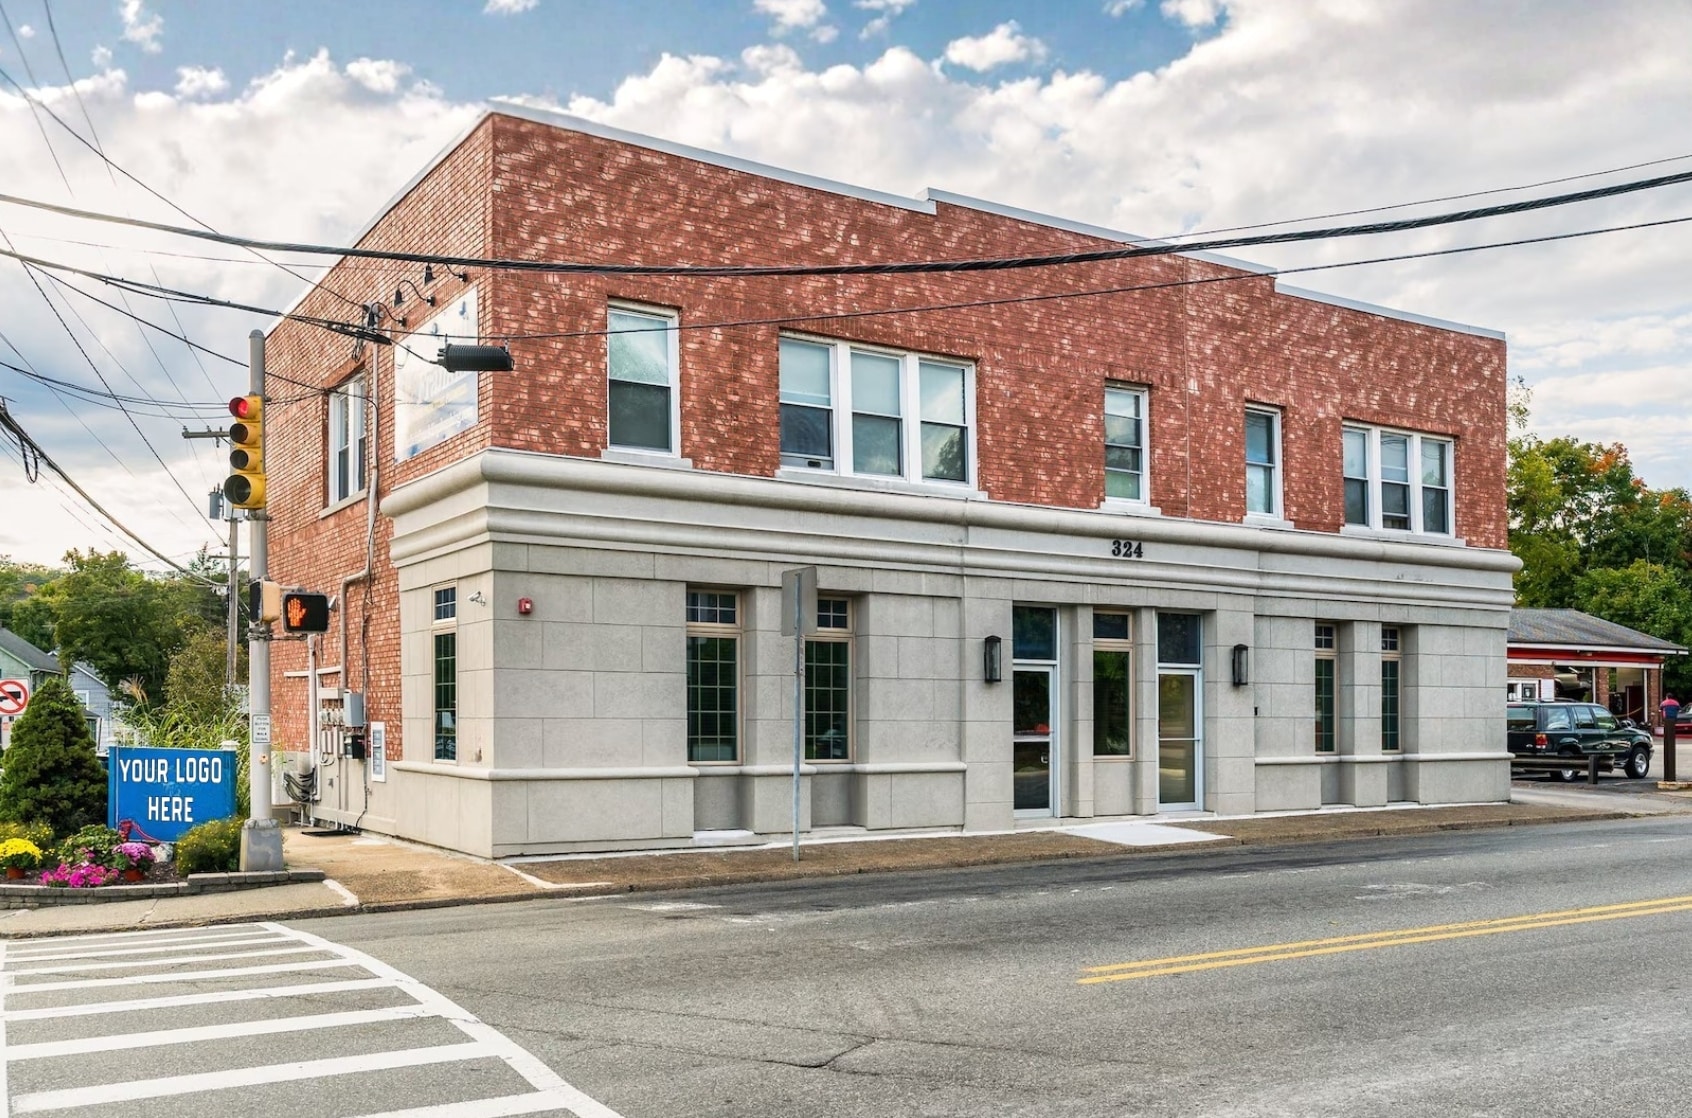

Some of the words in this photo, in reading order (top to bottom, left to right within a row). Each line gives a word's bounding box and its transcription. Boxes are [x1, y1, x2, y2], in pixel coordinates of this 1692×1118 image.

[1112, 540, 1143, 558] 324
[120, 759, 168, 782] YOUR
[176, 757, 222, 783] LOGO
[148, 796, 193, 822] HERE
